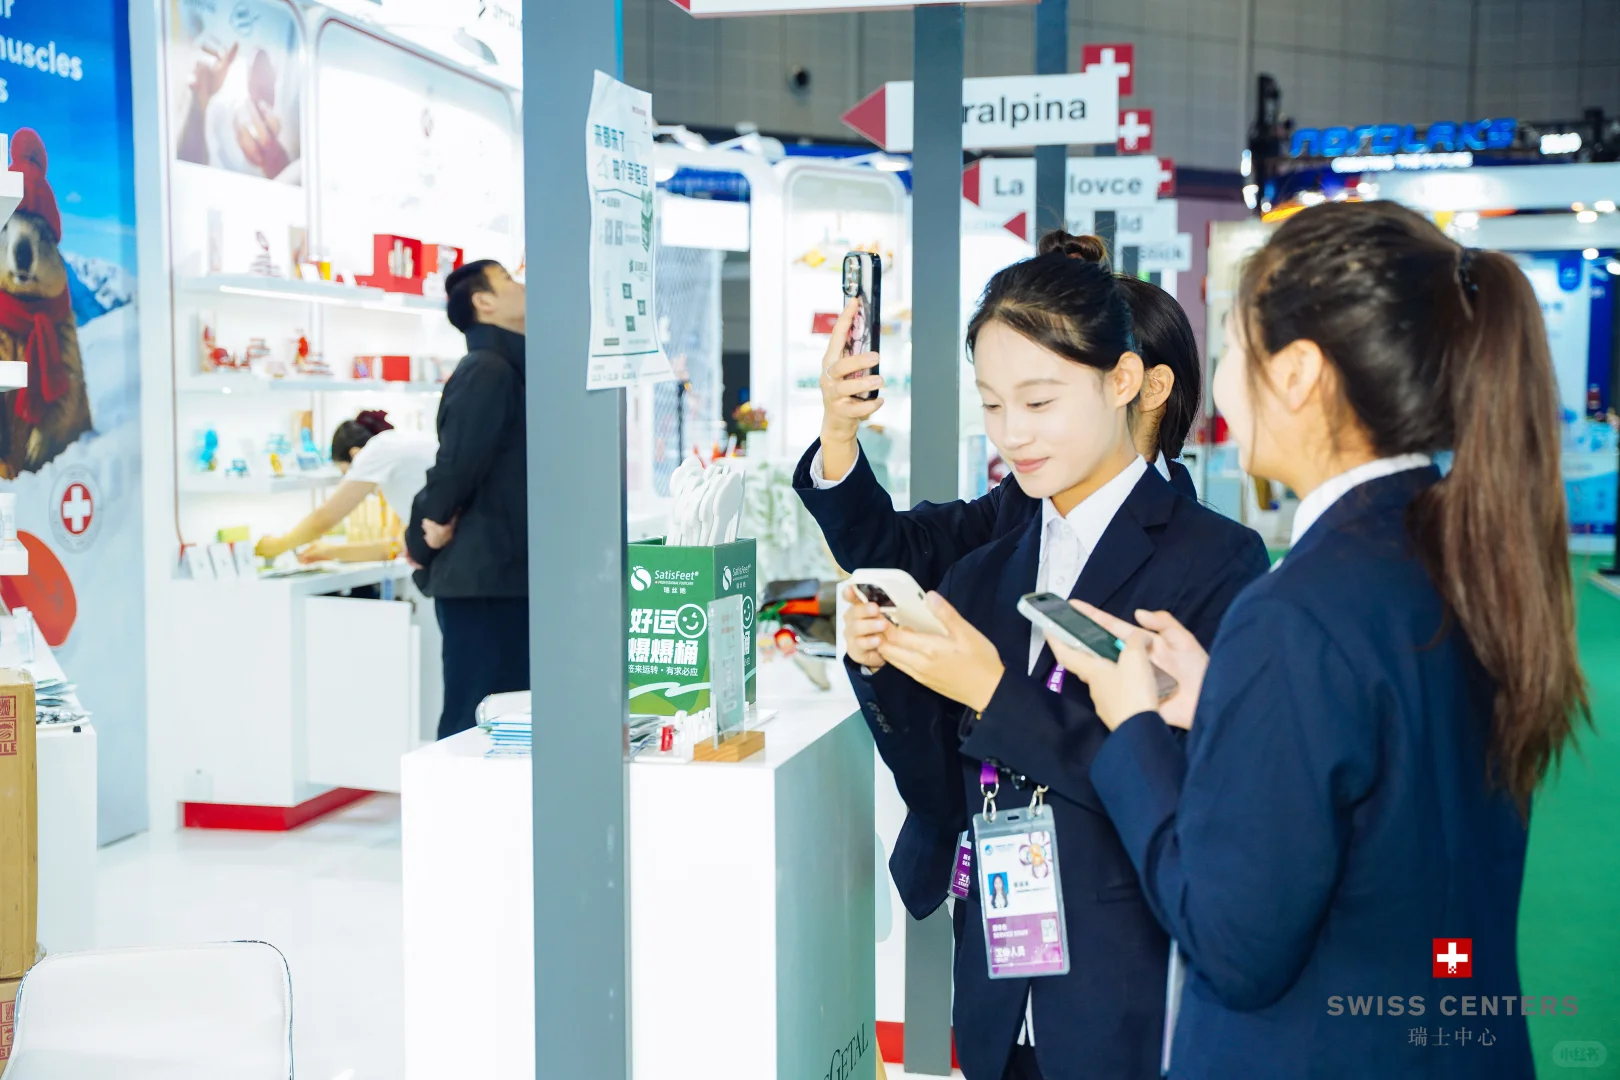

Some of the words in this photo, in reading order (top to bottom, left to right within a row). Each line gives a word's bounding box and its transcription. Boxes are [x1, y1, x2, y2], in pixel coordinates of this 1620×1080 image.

[962, 94, 1086, 128] ralpina
[993, 176, 1025, 196] La
[1069, 174, 1143, 196] lovce
[628, 608, 677, 634] 好运
[823, 1022, 869, 1080] GETAL
